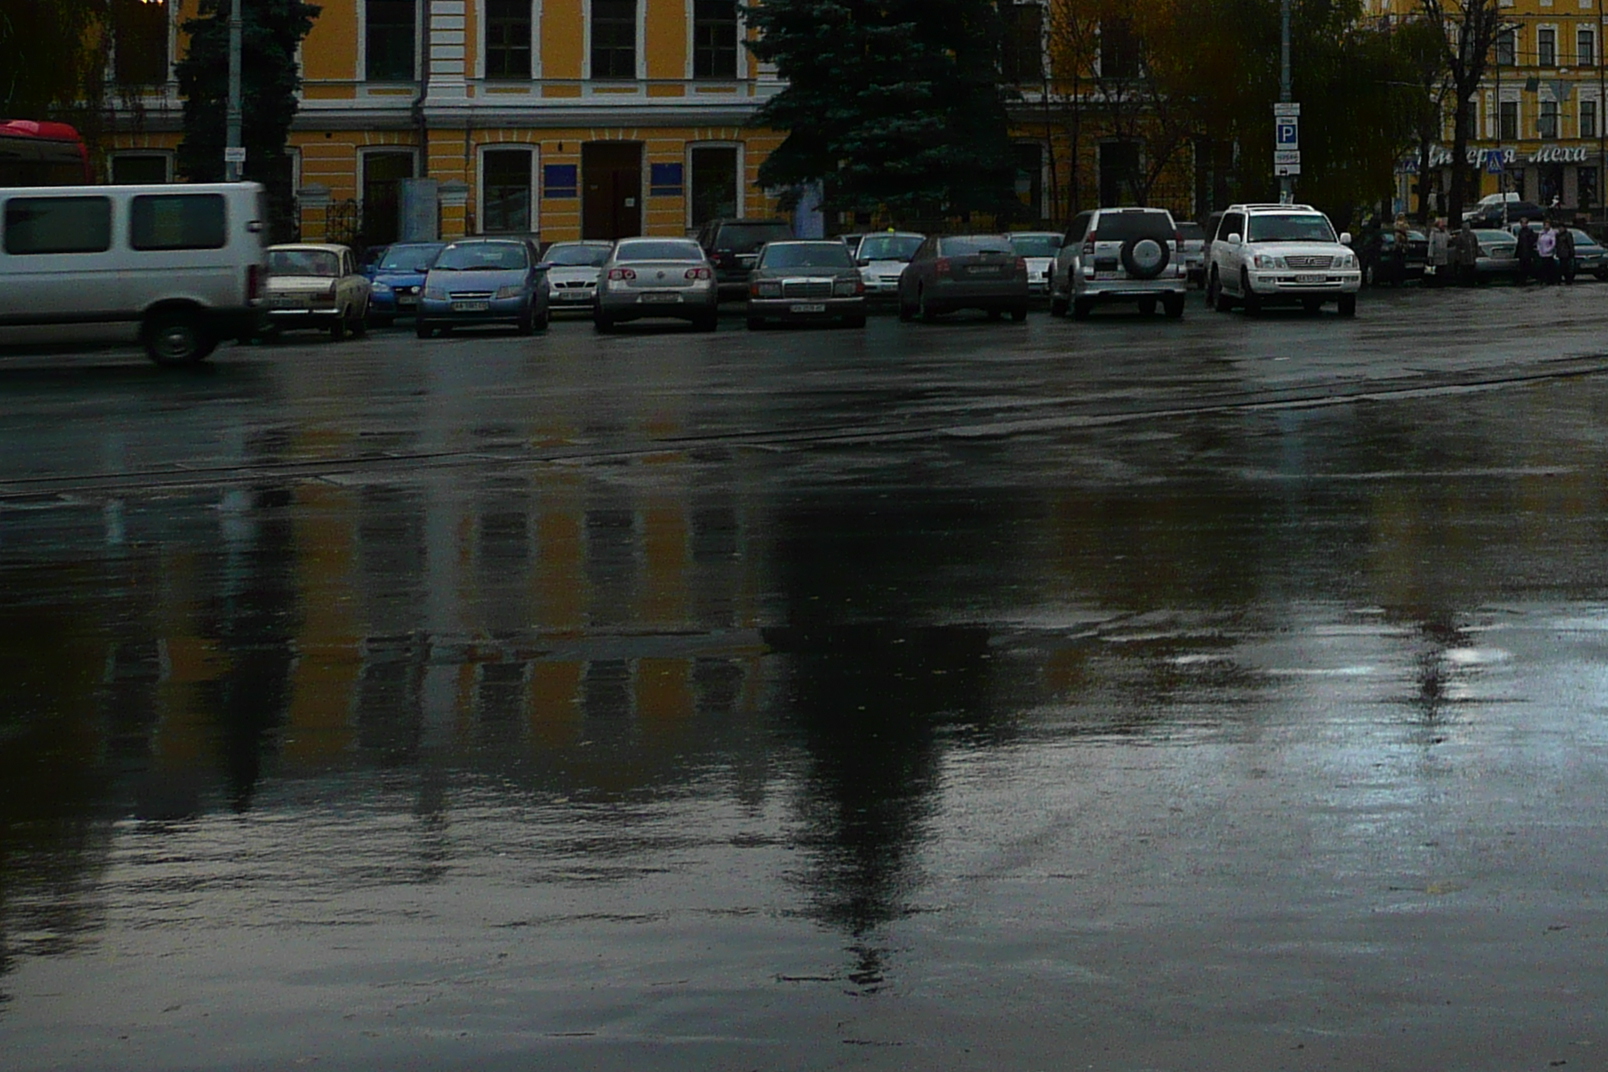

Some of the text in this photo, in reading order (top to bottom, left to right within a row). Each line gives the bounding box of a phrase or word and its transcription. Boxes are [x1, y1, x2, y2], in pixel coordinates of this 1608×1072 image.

[1282, 126, 1294, 142] P
[1415, 144, 1588, 169] Имеря меха
